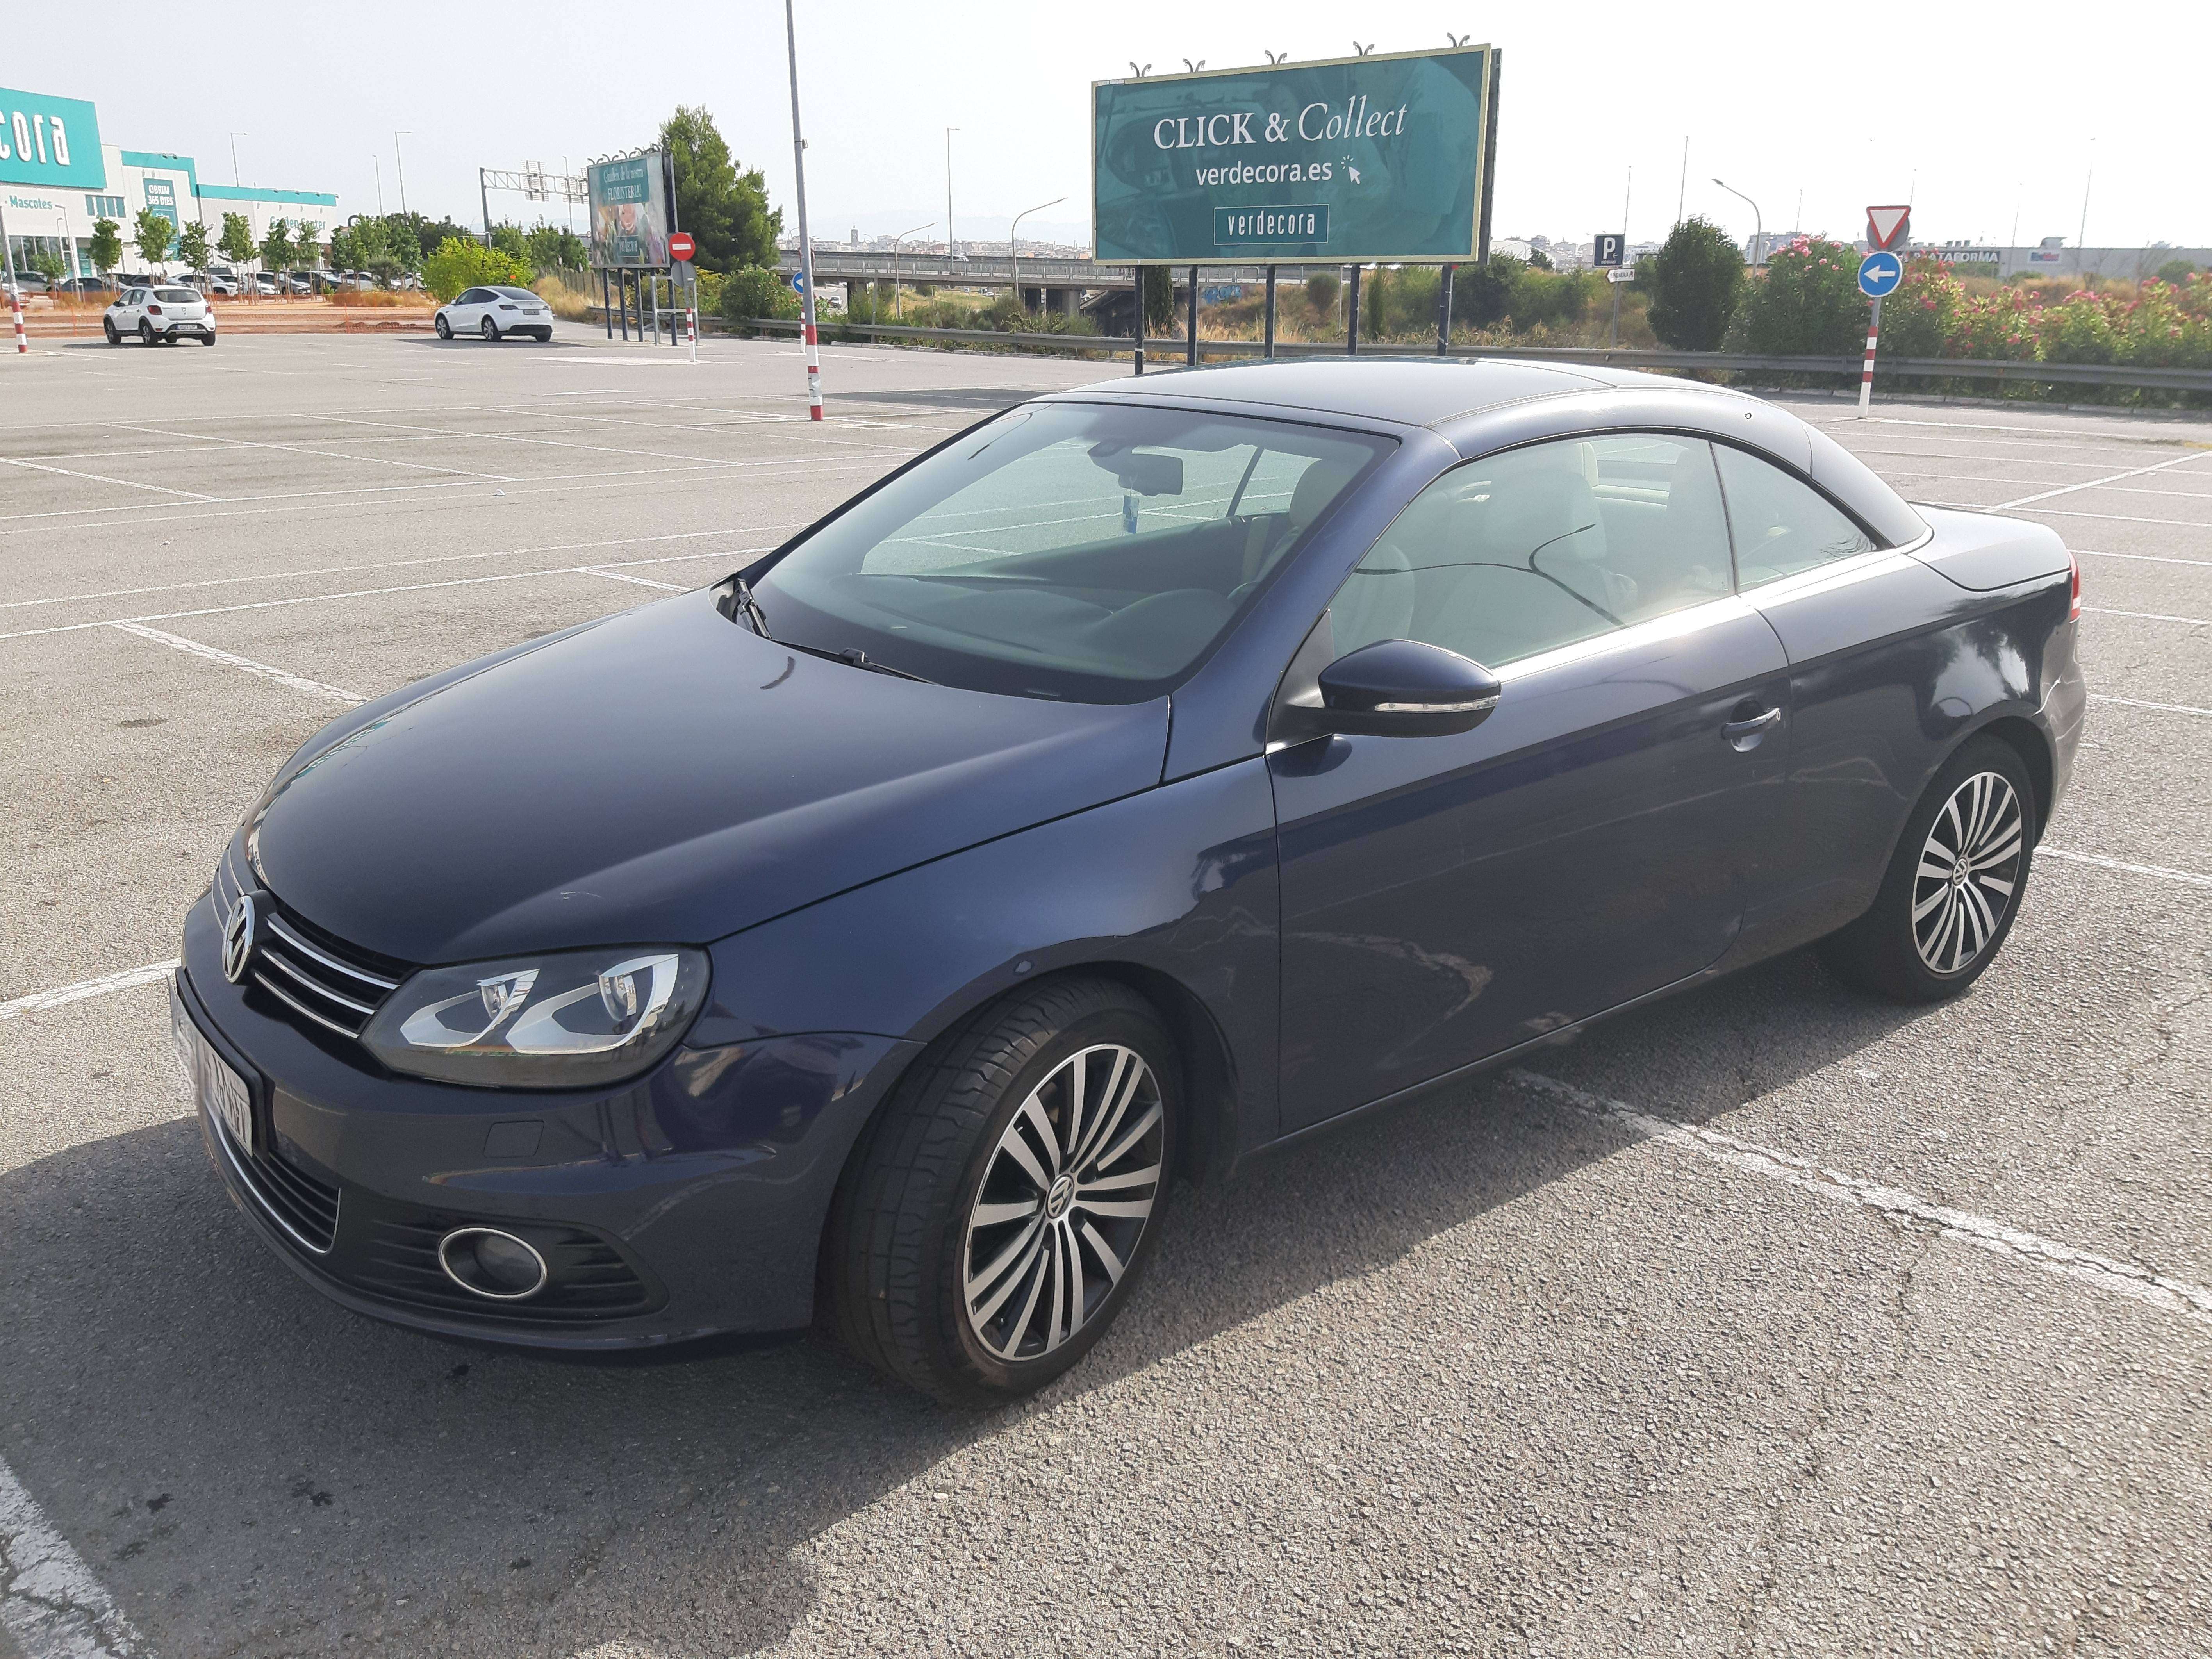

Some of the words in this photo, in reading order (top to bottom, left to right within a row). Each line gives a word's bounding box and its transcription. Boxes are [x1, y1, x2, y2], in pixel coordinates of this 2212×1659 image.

[1154, 112, 1257, 149] CLICK
[1265, 112, 1290, 142] &
[1299, 94, 1407, 141] Collect
[1196, 161, 1332, 186] verdecora.es
[149, 185, 170, 194] OBRIM
[9, 195, 53, 209] Mascotes
[147, 196, 159, 205] 365
[160, 196, 173, 205] DIES
[1228, 210, 1315, 235] verdecora
[1603, 237, 1616, 259] P
[1914, 251, 1999, 262] PATAFORMA
